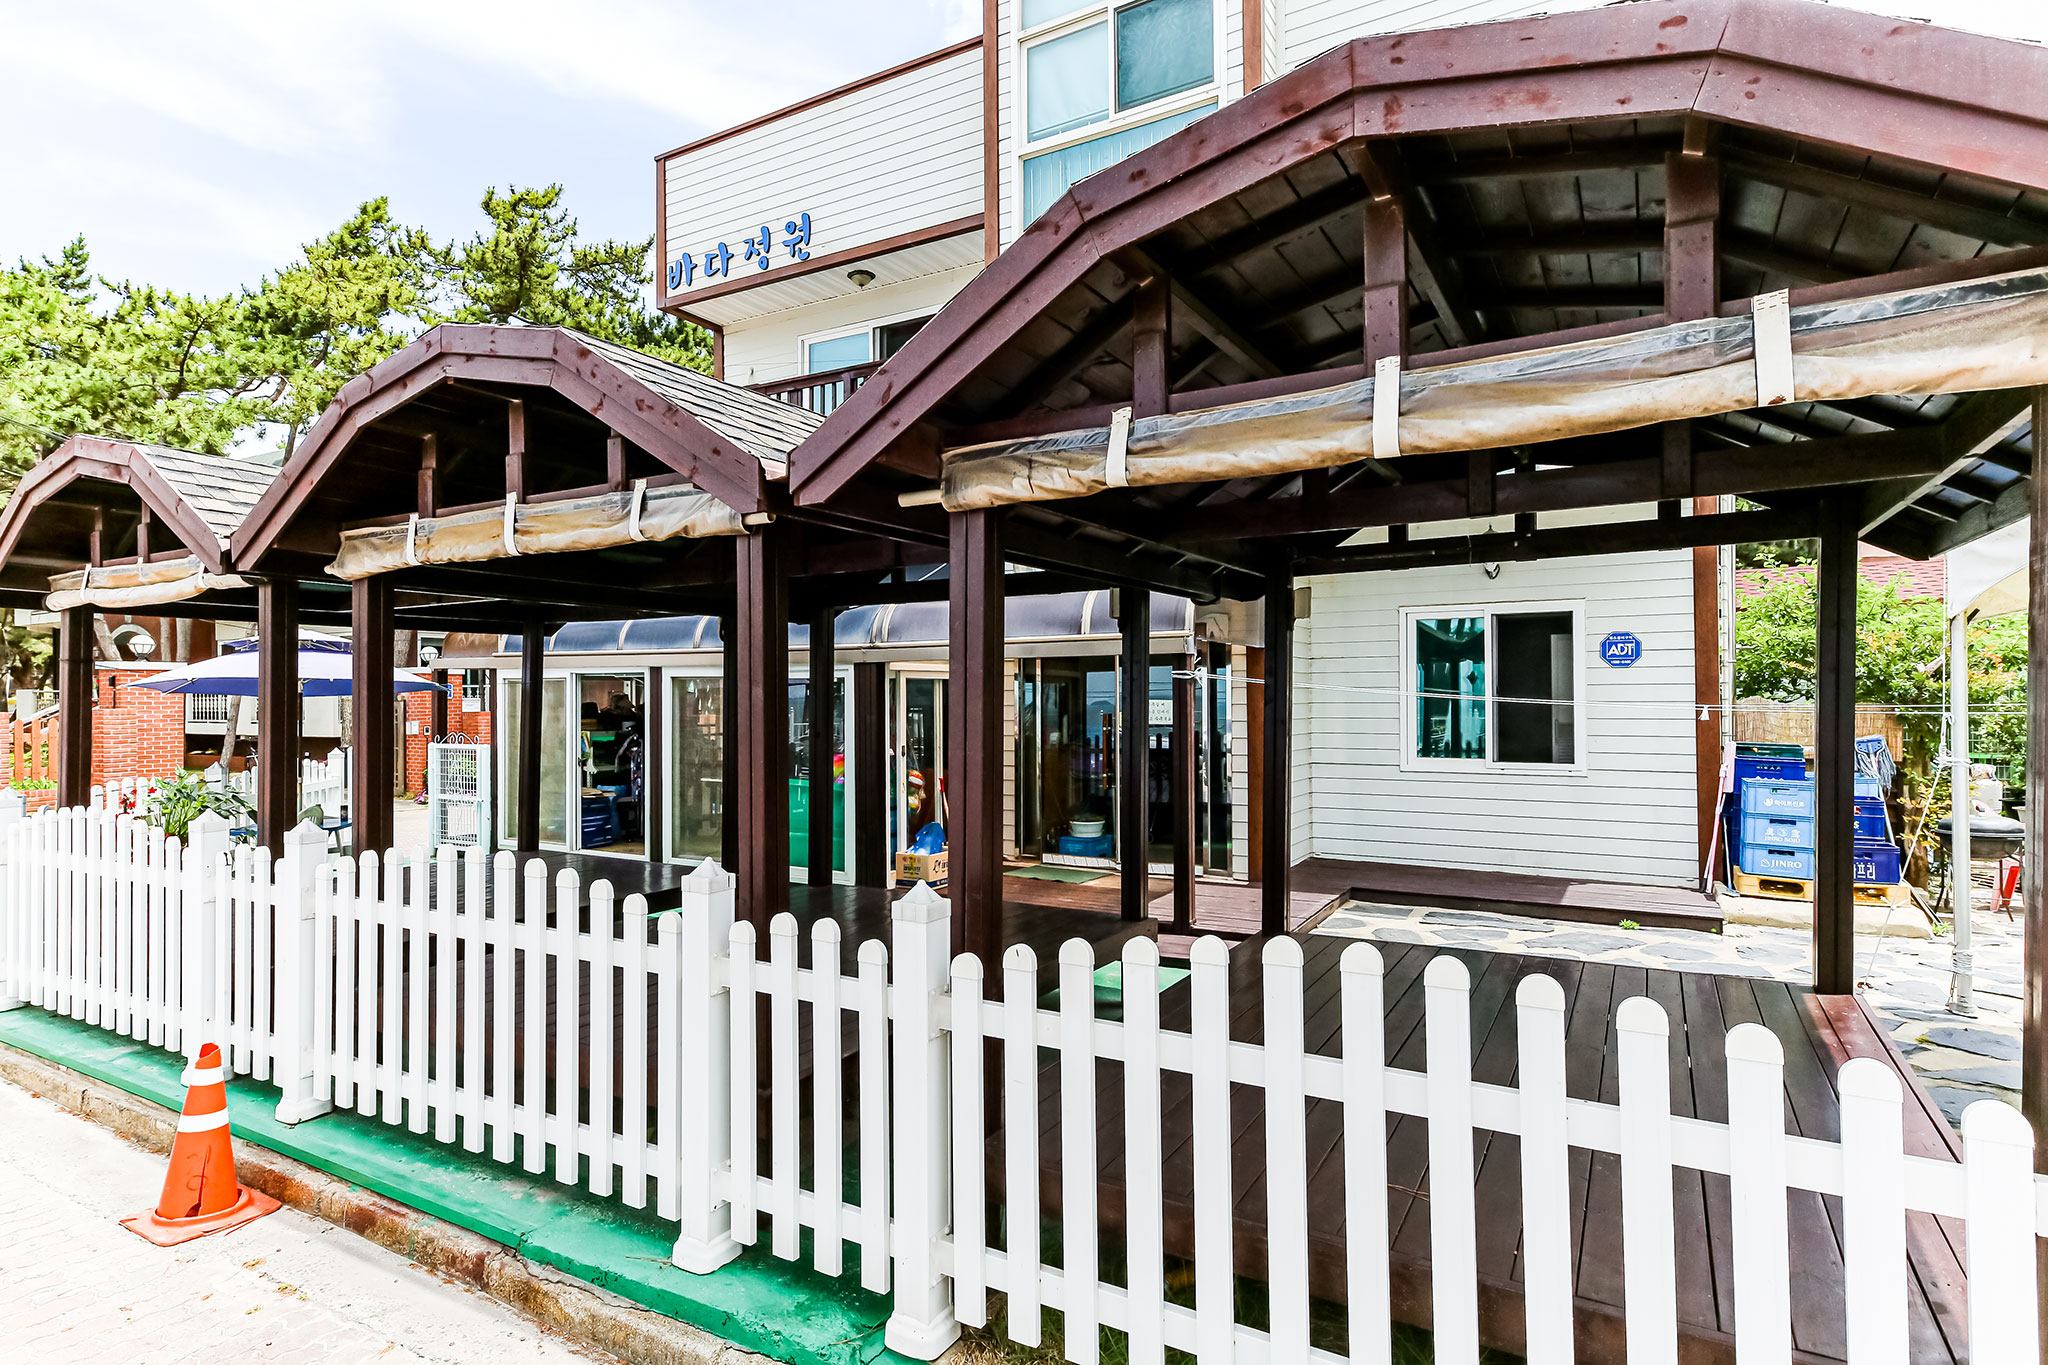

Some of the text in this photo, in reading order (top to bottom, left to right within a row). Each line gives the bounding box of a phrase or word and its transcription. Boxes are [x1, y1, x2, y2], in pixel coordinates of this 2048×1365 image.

[668, 212, 811, 290] 바다정원
[1608, 643, 1634, 656] ADT
[1771, 859, 1803, 869] JINRO
